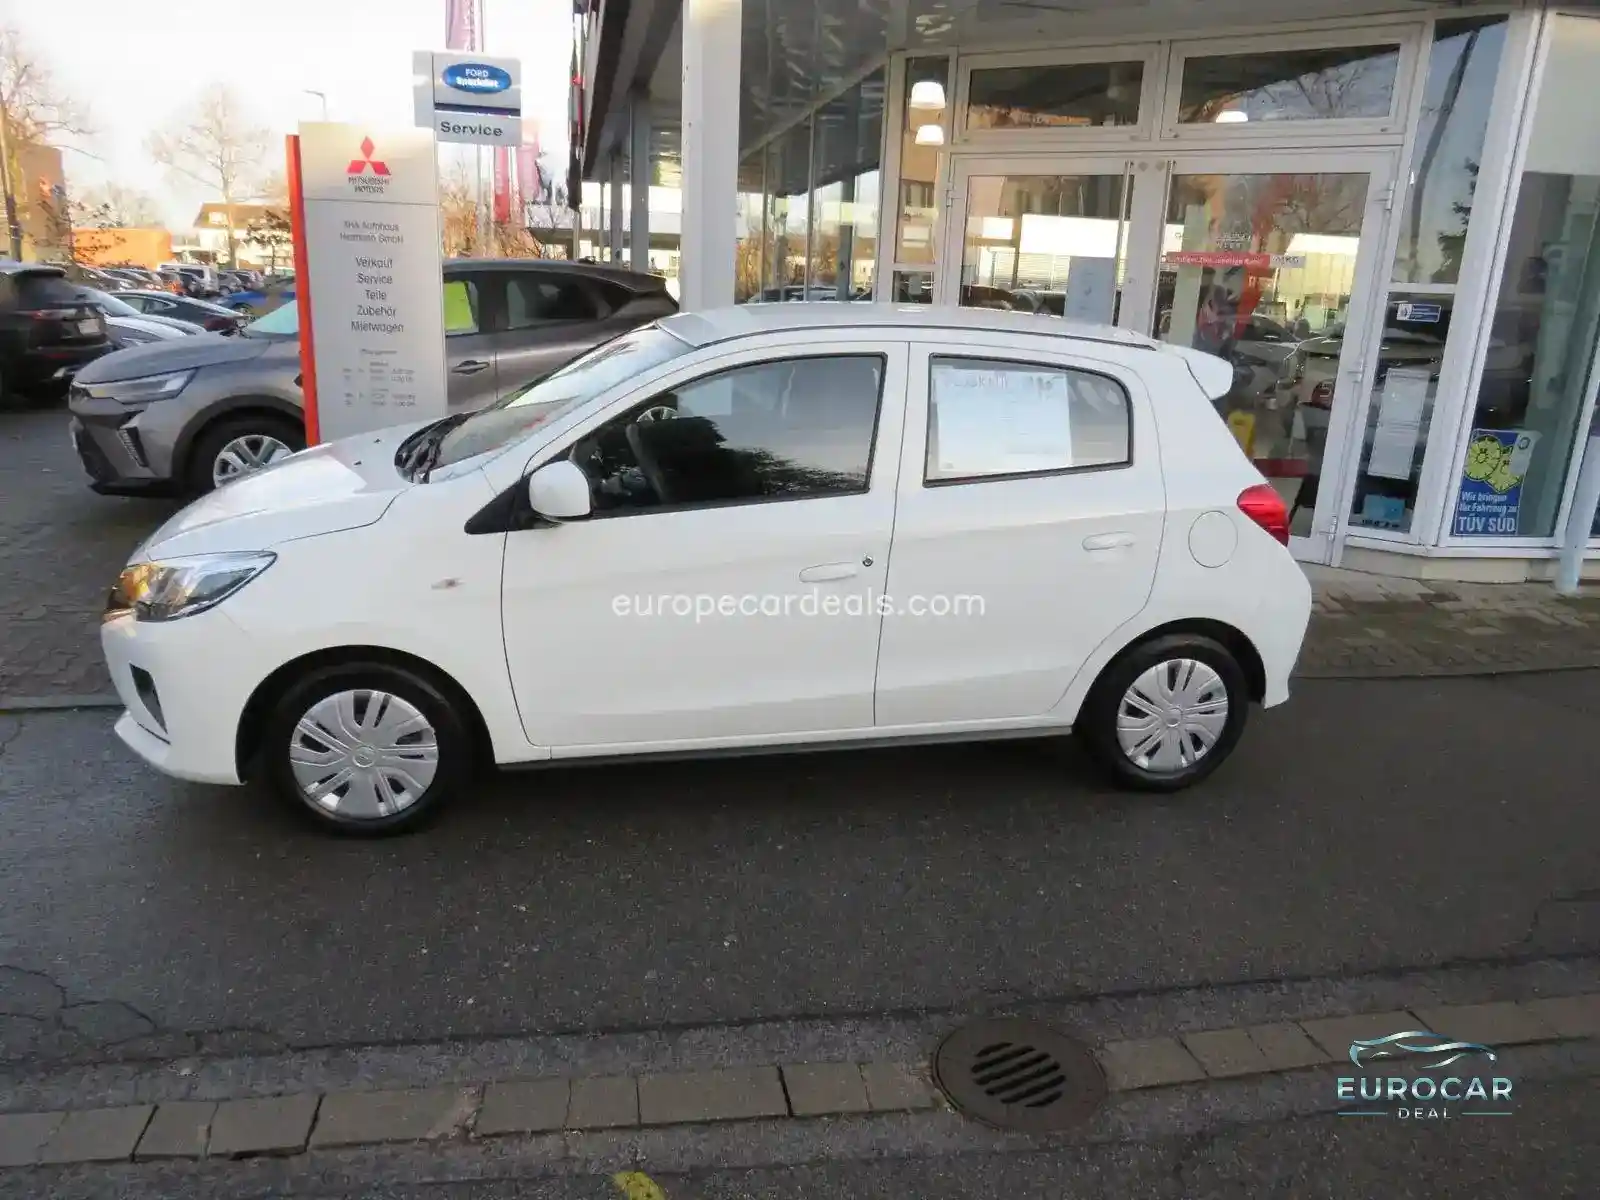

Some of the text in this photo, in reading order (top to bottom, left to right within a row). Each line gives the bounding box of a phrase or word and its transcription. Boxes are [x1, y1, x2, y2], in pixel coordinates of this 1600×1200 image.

[465, 68, 489, 78] FORD
[440, 120, 503, 136] Service
[354, 185, 384, 194] MOTORS
[378, 233, 404, 245] GmbH
[355, 256, 393, 269] Verkauf
[356, 273, 393, 285] Service
[365, 289, 387, 301] Teile
[356, 305, 396, 318] Zubehör
[351, 321, 404, 334] Mietwagen
[1459, 512, 1486, 532] TÜV
